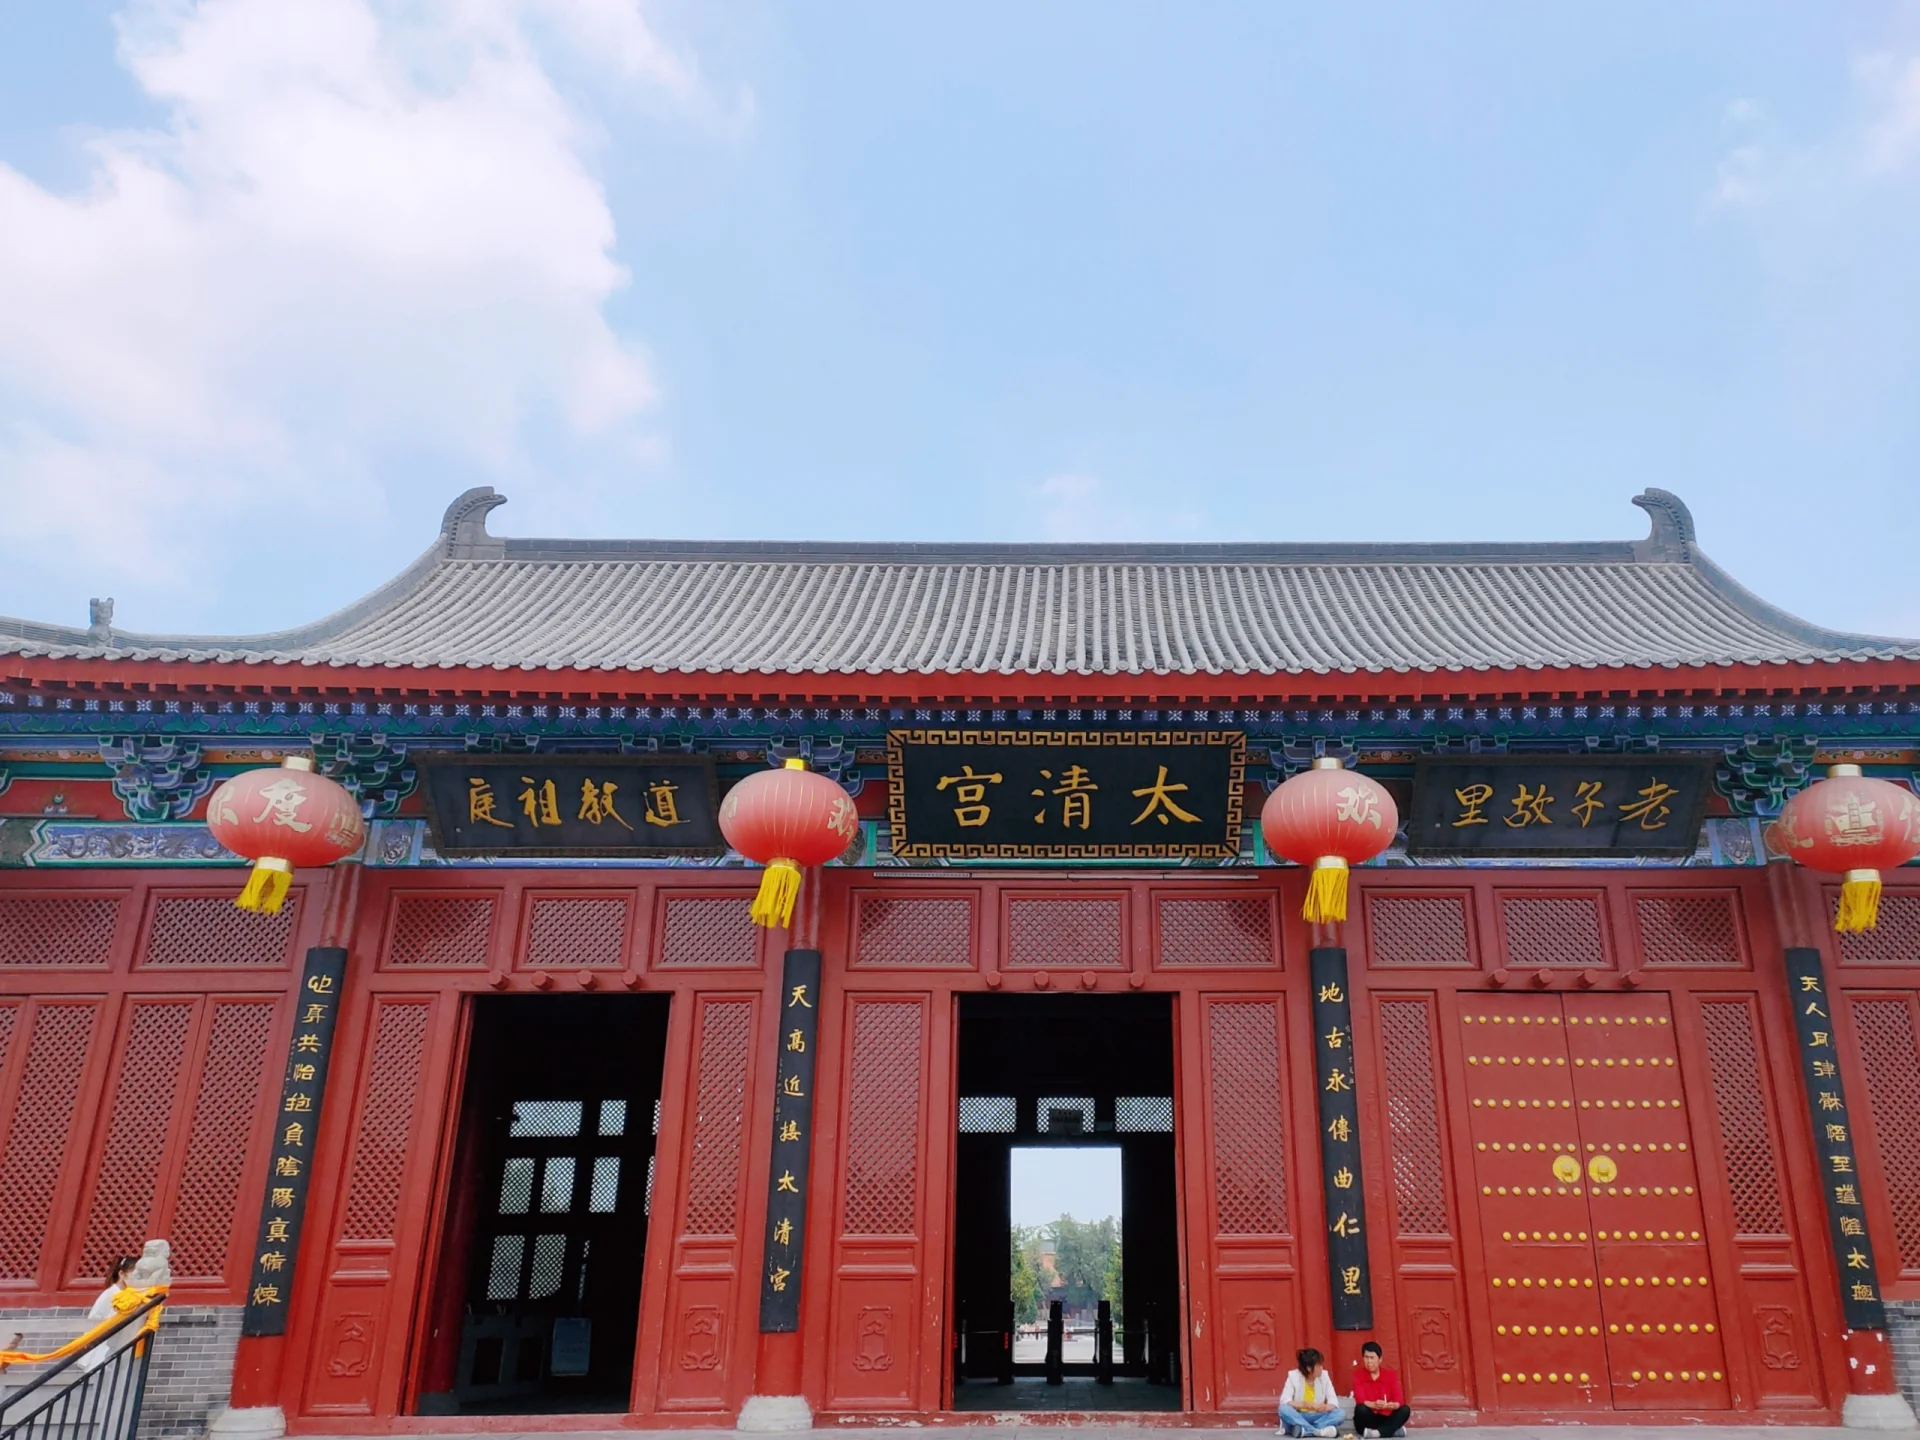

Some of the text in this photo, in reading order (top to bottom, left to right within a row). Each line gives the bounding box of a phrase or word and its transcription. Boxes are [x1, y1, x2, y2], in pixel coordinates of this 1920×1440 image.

[1451, 777, 1680, 830] 老子故里
[1318, 981, 1361, 1295] 地古永傳曲仁里
